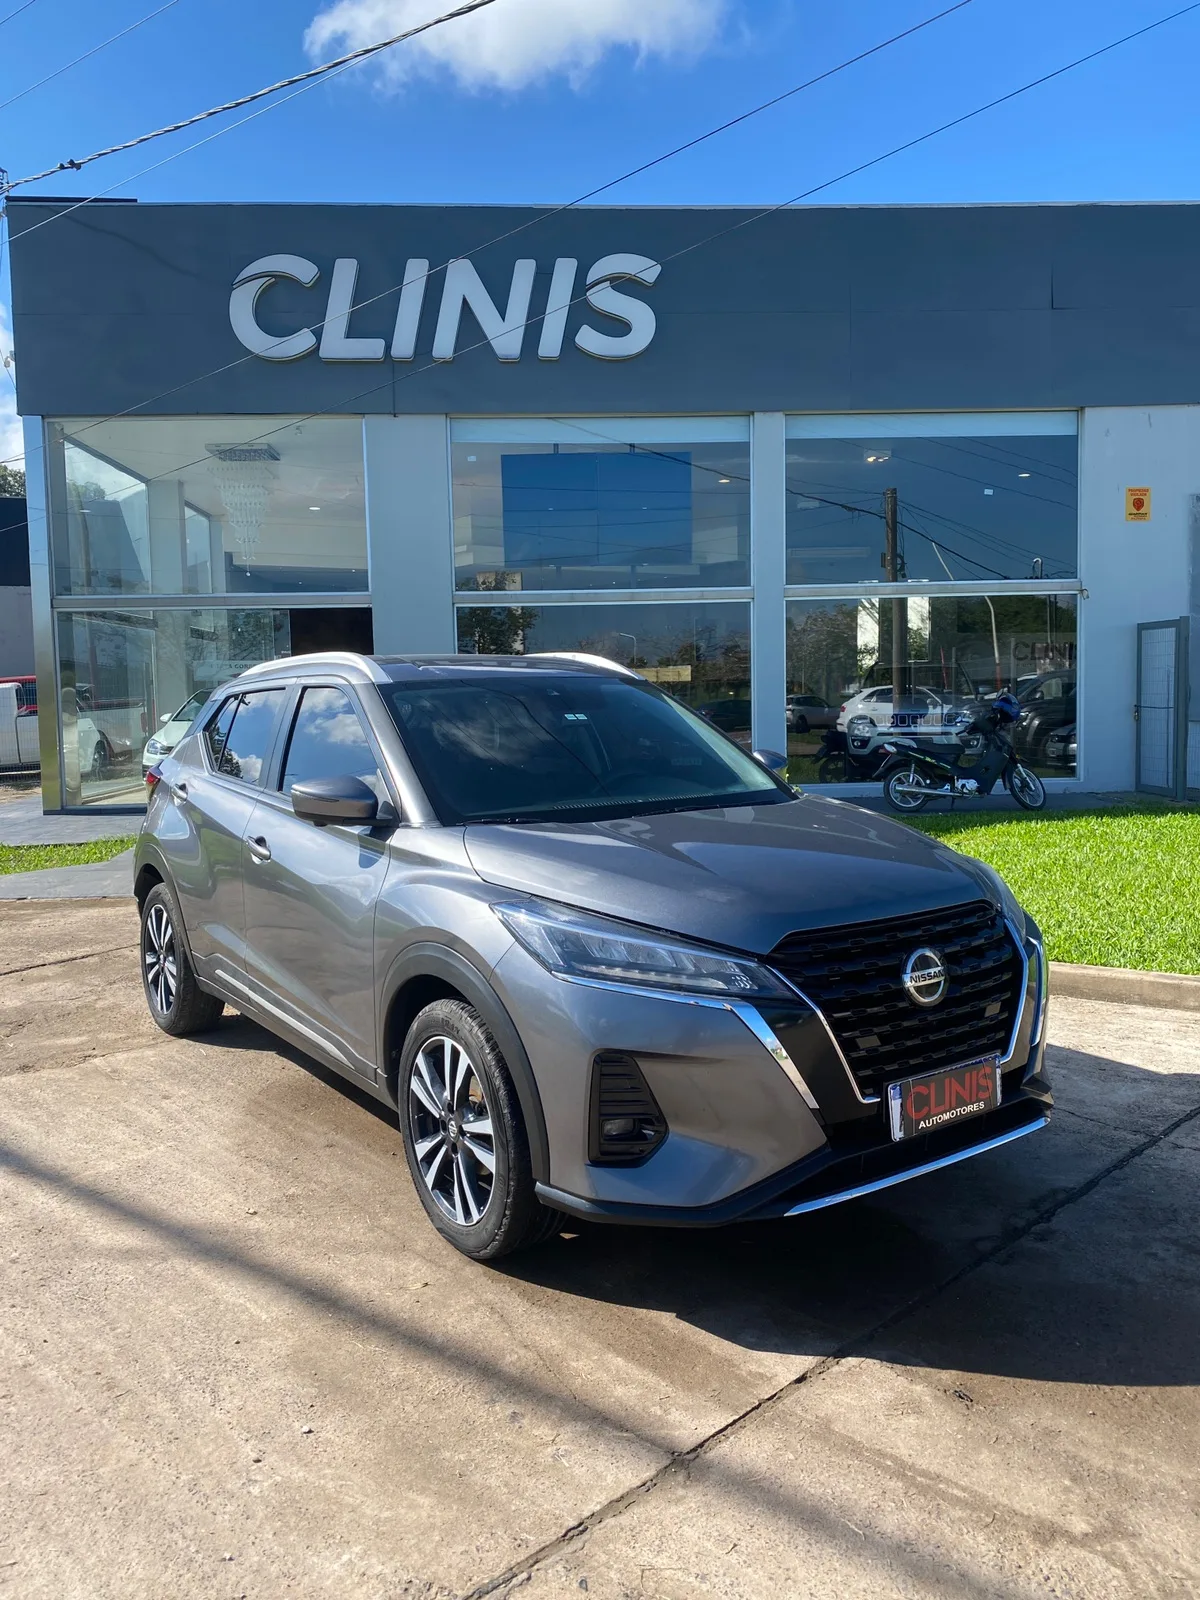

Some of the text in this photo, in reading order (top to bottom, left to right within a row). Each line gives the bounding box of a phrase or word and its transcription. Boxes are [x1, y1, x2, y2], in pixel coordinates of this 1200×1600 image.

[229, 253, 662, 361] CLINIS
[1013, 642, 1076, 661] CLINI
[910, 969, 944, 984] NISSAN
[906, 1066, 993, 1120] CLINIS
[919, 1101, 985, 1130] AUTOMOTORES
